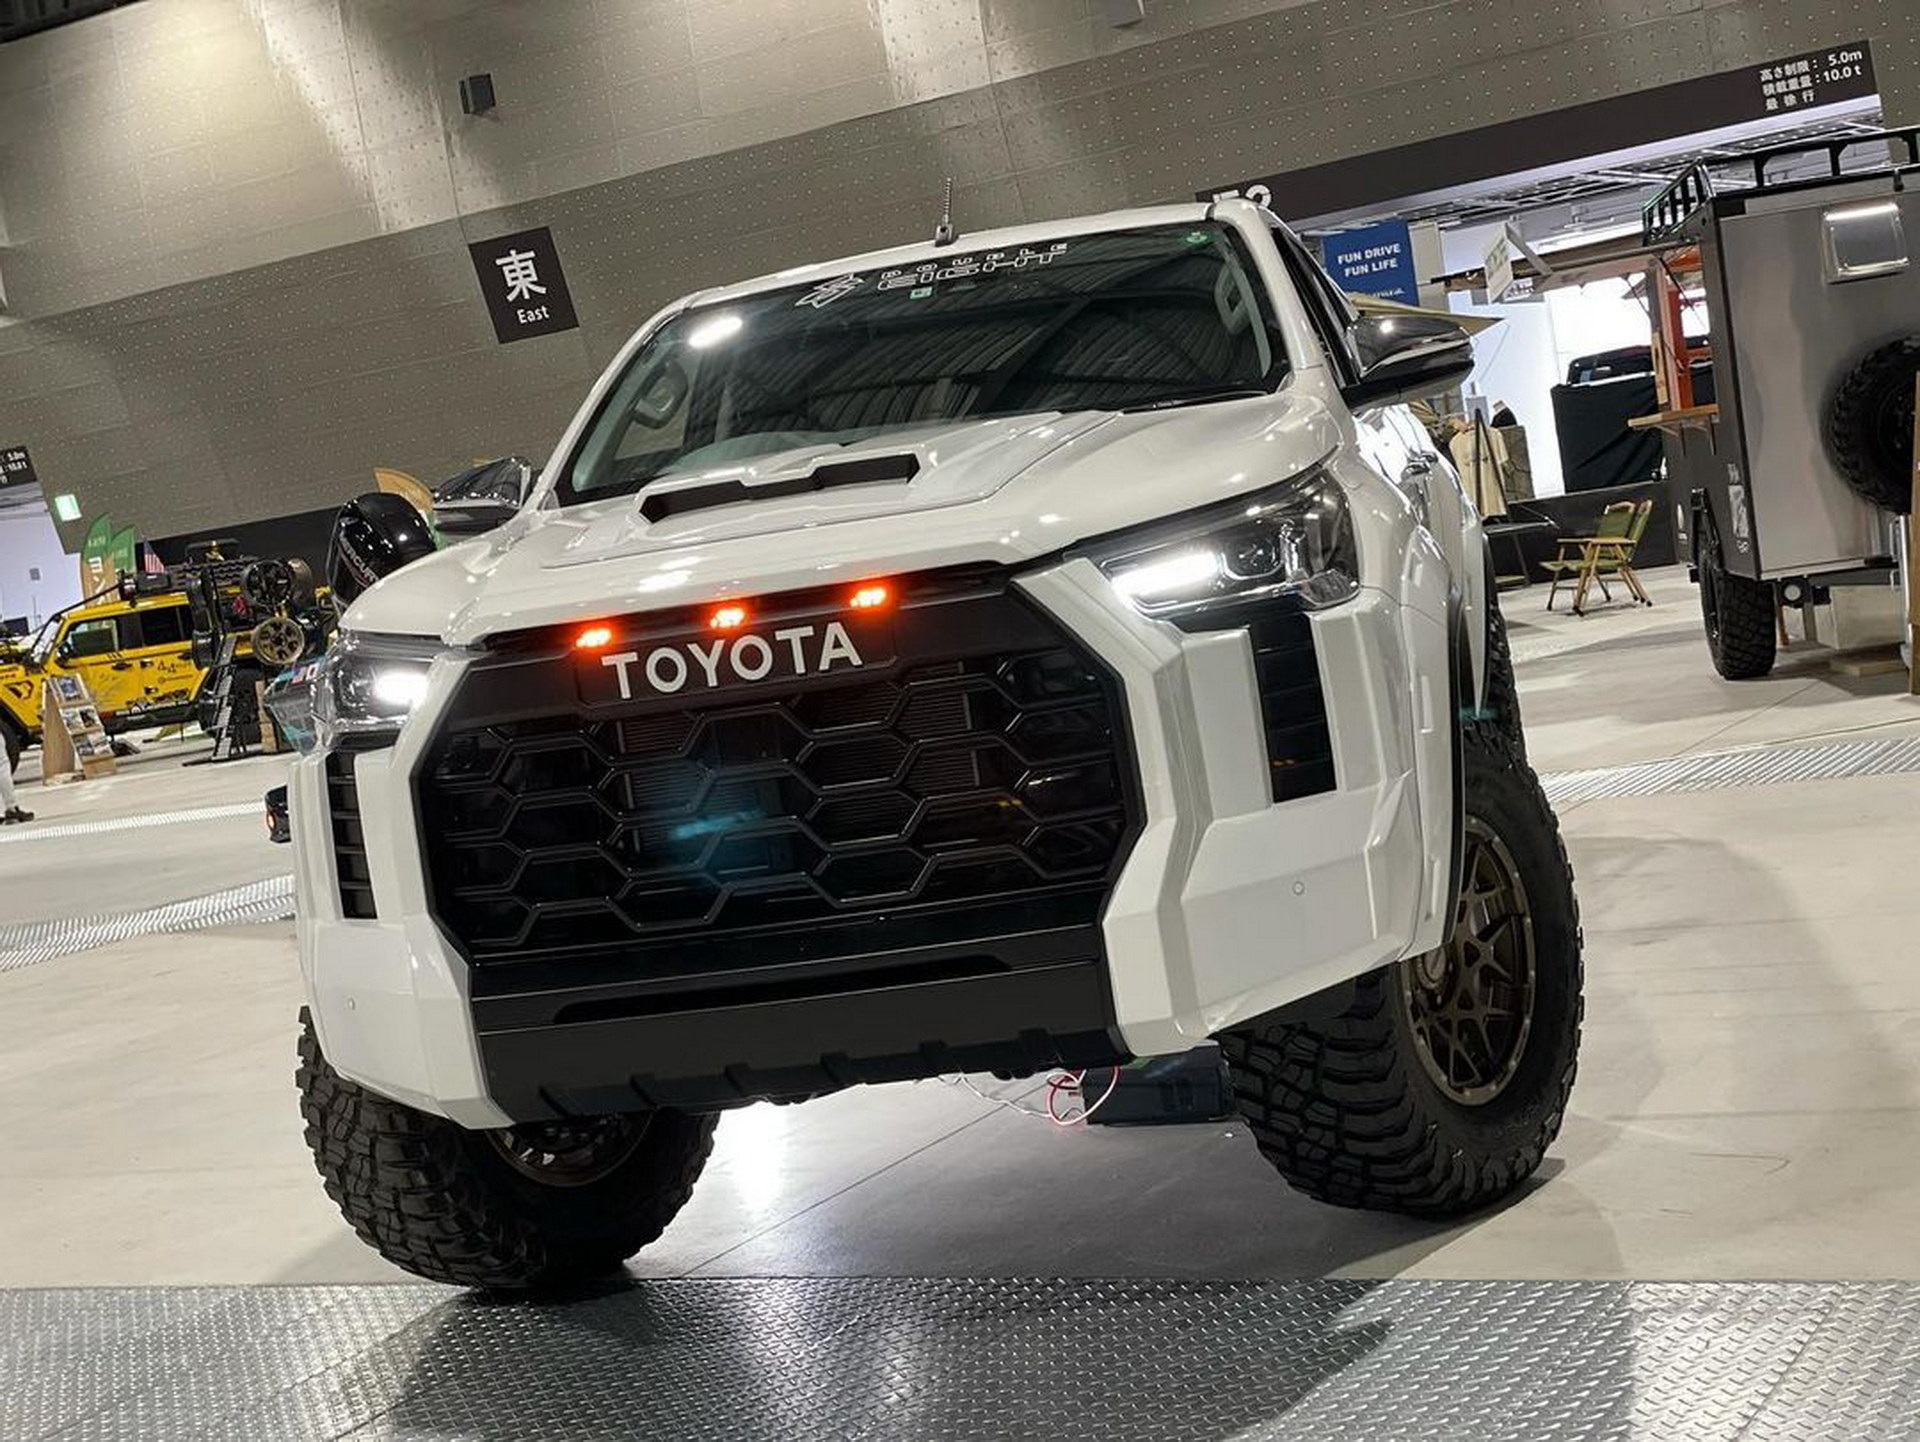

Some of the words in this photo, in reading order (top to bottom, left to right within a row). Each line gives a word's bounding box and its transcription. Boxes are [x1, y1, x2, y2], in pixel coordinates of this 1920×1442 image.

[1828, 50, 1863, 67] 5.0m
[1337, 251, 1362, 265] FUN
[1364, 243, 1401, 259] DRIVE
[495, 249, 547, 302] 東
[1344, 264, 1369, 278] FUN
[1371, 257, 1398, 272] LIFE
[516, 305, 550, 324] East
[601, 621, 863, 700] TOYOTA
